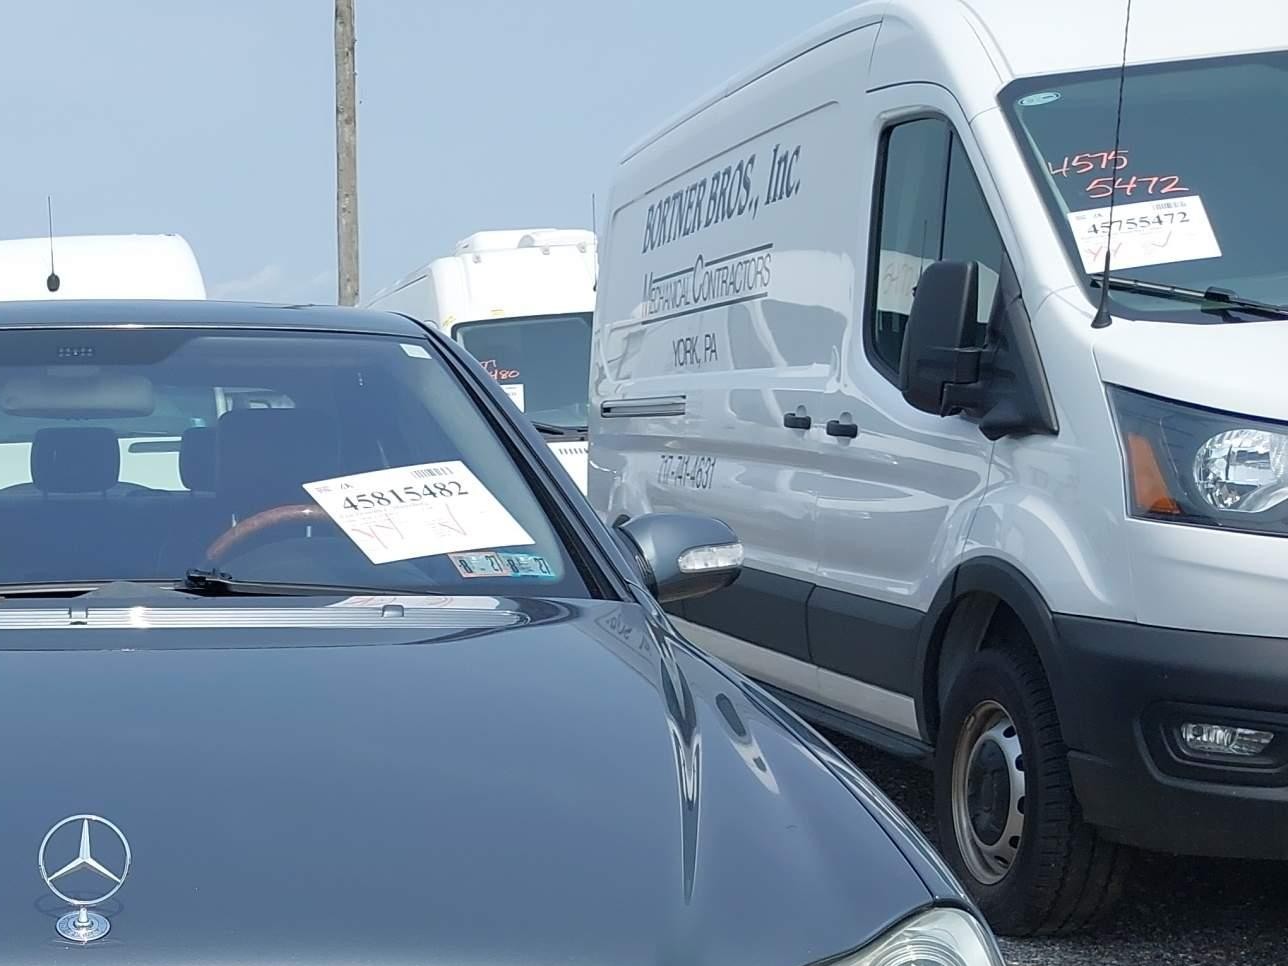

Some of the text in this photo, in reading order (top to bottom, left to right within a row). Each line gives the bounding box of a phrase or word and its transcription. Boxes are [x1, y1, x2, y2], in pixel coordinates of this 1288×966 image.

[1048, 149, 1129, 178] 4575
[642, 178, 707, 254] BORTNER
[765, 143, 801, 206] Inc.
[1085, 175, 1190, 199] 5472
[1087, 211, 1190, 235] 45755472
[672, 332, 718, 368] YORK, PA
[343, 480, 469, 511] 45815482
